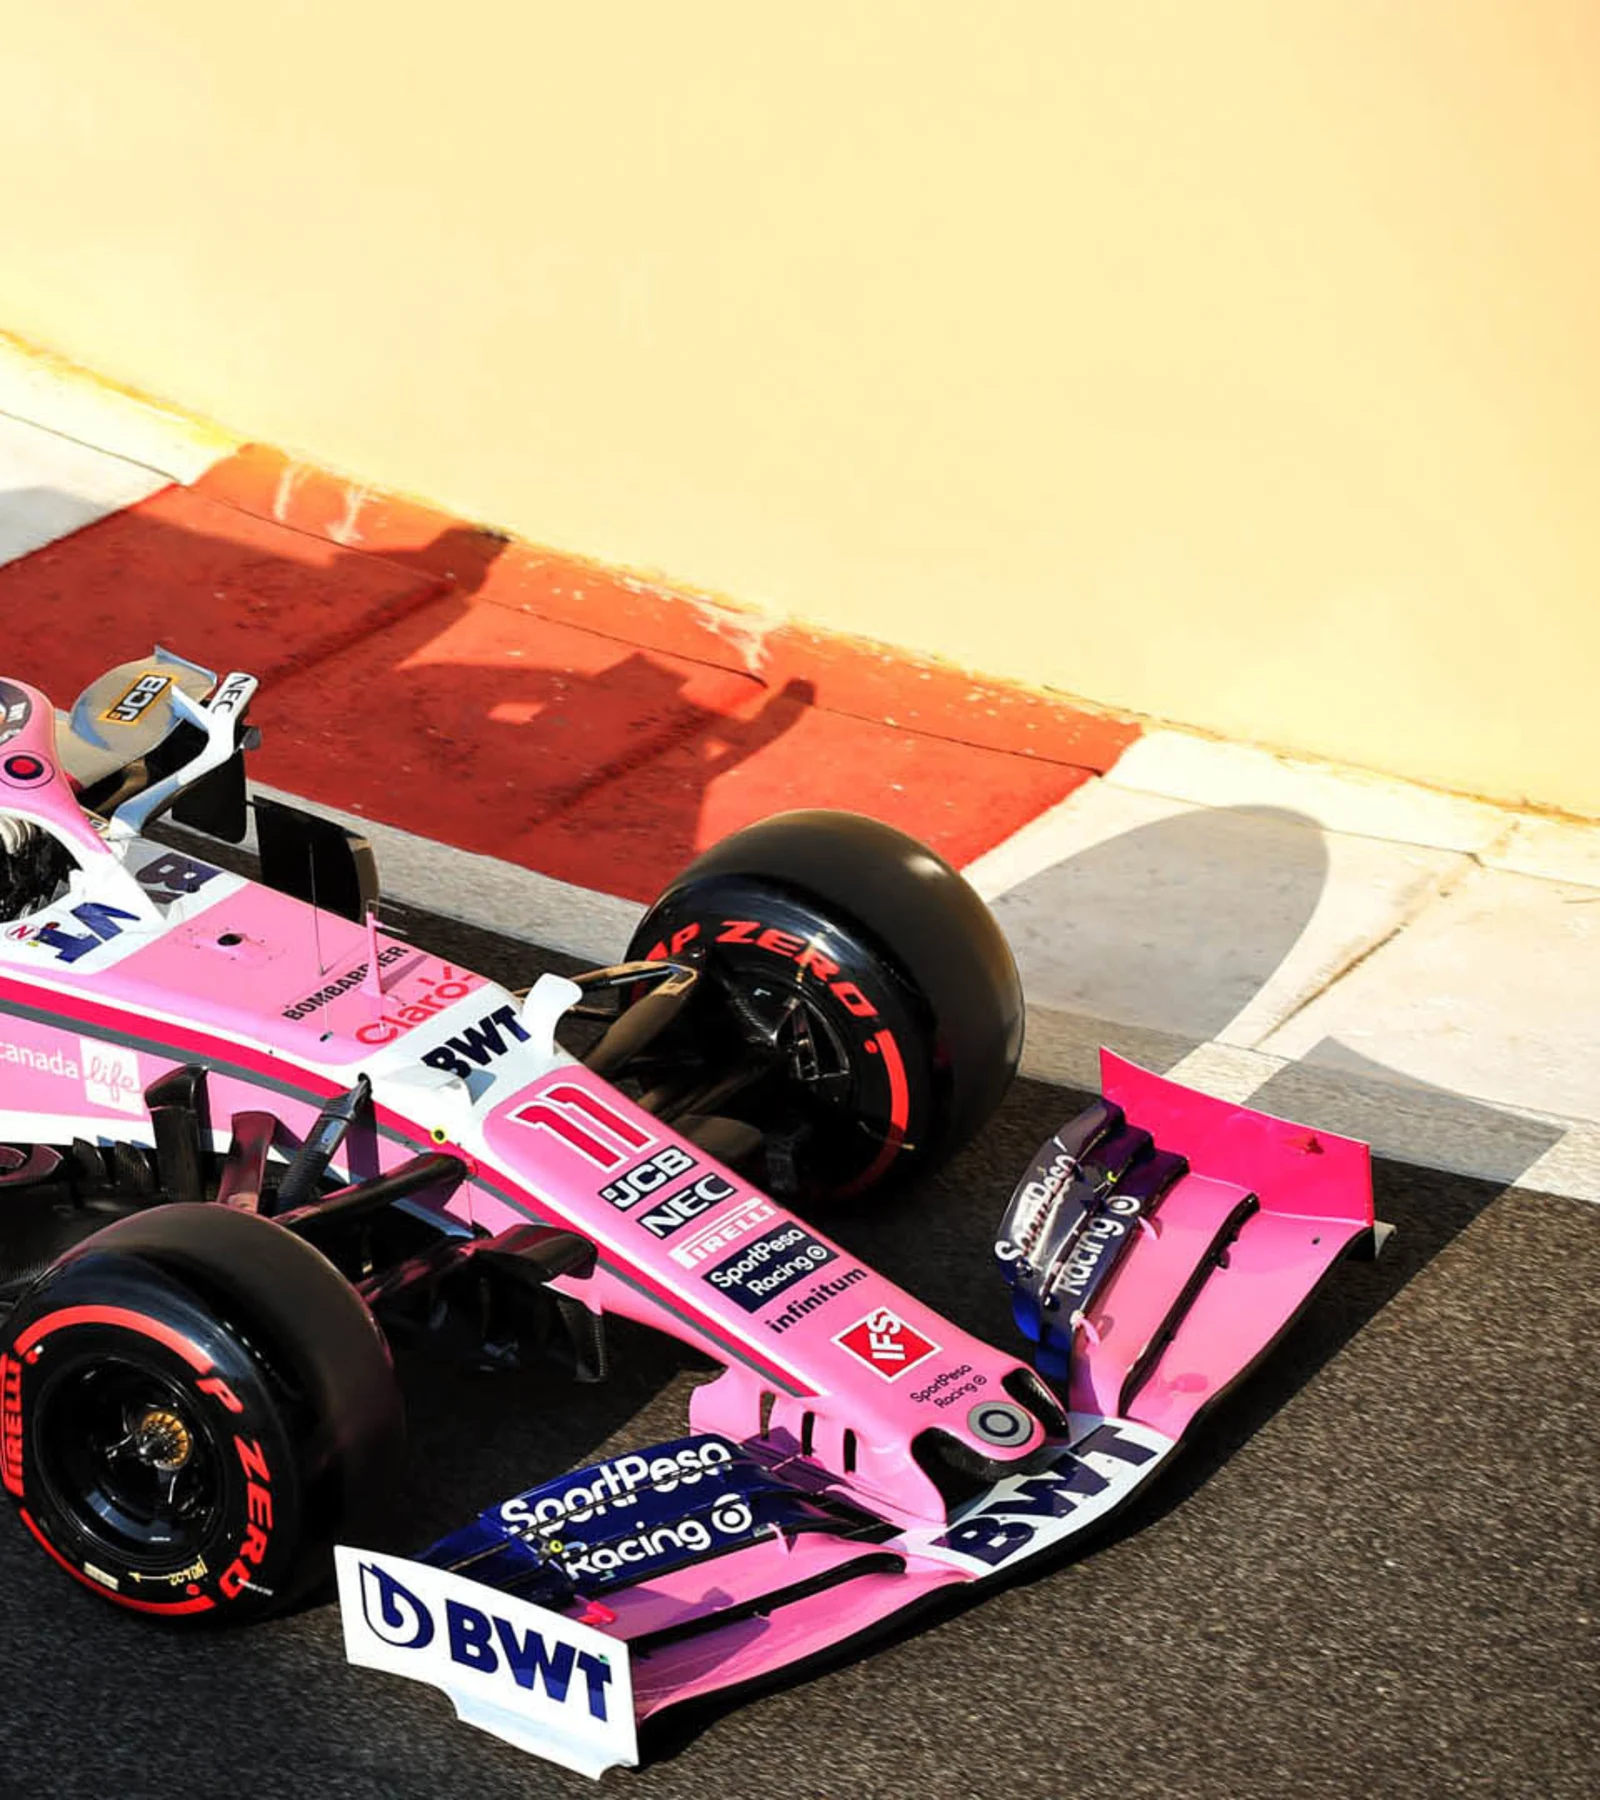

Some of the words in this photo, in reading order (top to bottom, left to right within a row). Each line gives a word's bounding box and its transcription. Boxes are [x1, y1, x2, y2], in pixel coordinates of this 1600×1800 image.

[116, 674, 171, 721] JCB
[212, 675, 251, 714] NEC
[715, 920, 879, 1018] ZERO
[355, 981, 469, 1045] Claro
[420, 1004, 532, 1079] BWT
[84, 1055, 143, 1103] life
[509, 1083, 658, 1172] 11
[606, 1148, 695, 1209] JCB
[640, 1174, 735, 1237] NEC
[668, 1197, 777, 1270] PIRELLI
[710, 1228, 805, 1288] SportPesa
[1050, 1217, 1126, 1297] Racing
[746, 1254, 814, 1297] Racing
[765, 1267, 869, 1335] infinitum
[865, 1309, 907, 1362] IFS
[909, 1363, 972, 1404] SportPesa
[934, 1379, 978, 1410] Racing
[218, 1434, 274, 1600] ZERO
[500, 1442, 733, 1542] SportPesa
[928, 1423, 1160, 1567] BWT
[562, 1519, 712, 1581] Racing
[447, 1599, 613, 1722] BWT
